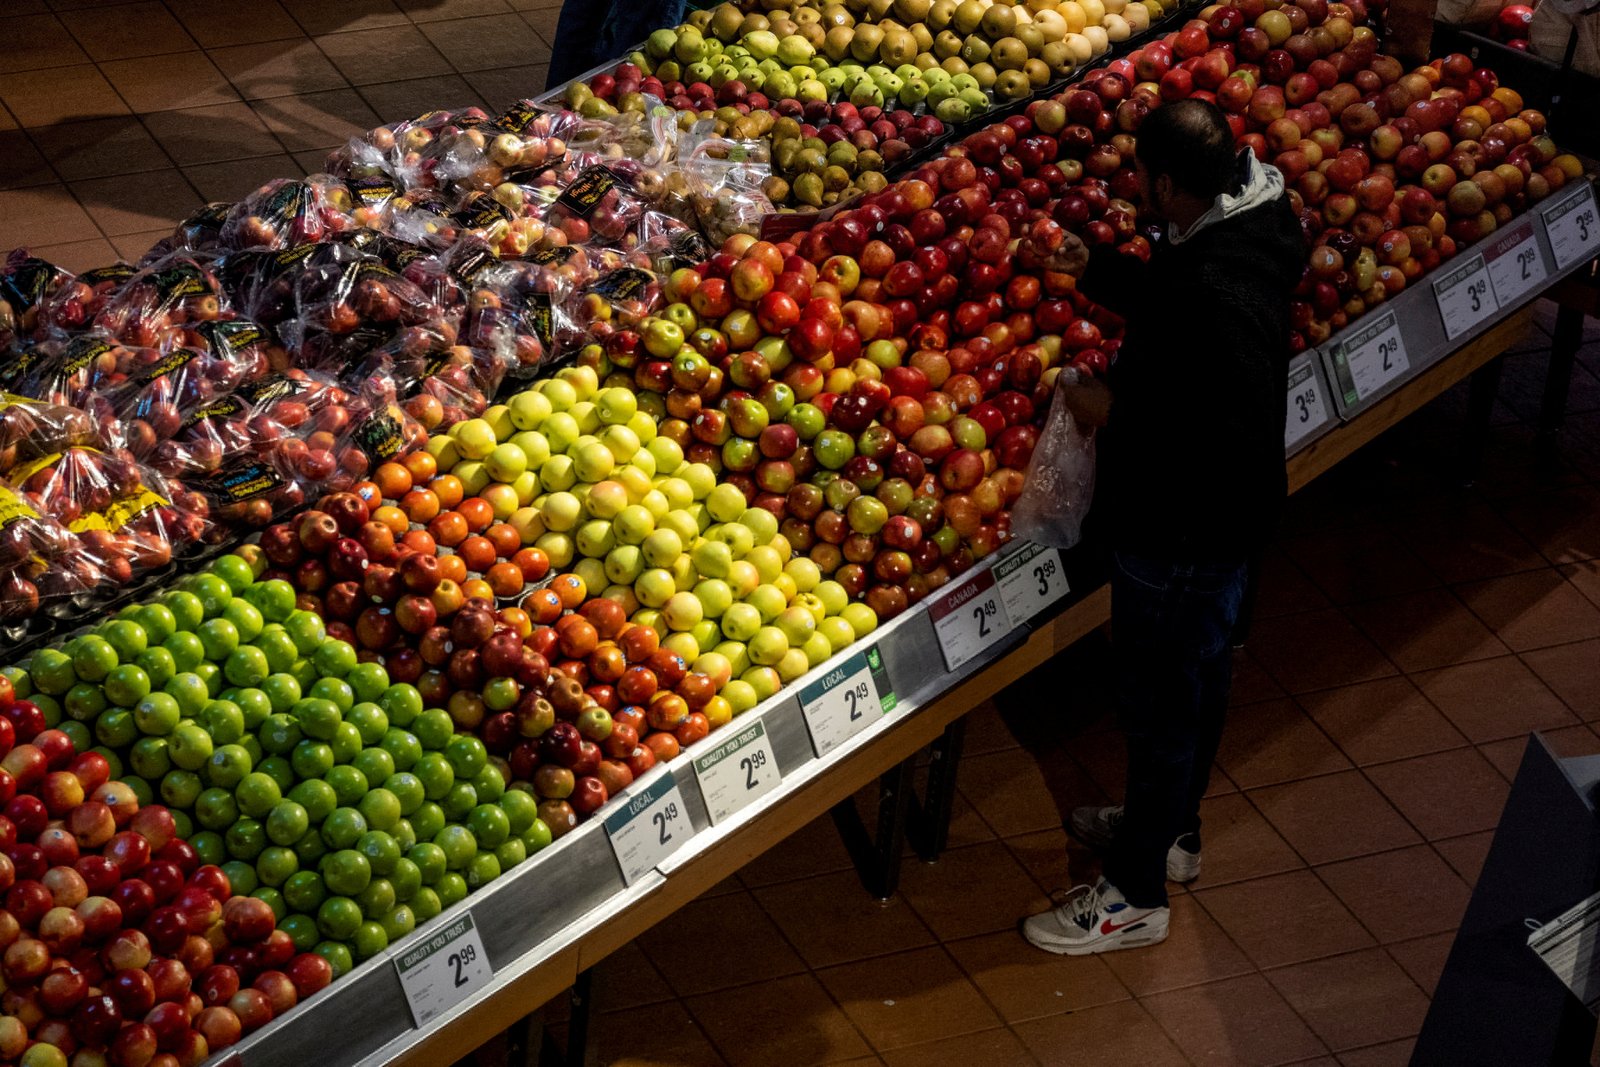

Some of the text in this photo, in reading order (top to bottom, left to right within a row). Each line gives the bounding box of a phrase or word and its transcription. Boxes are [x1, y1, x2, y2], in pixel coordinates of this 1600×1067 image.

[1497, 232, 1520, 254] CANADA
[948, 583, 979, 608] CANADA
[821, 668, 847, 690] LOCAL
[701, 727, 757, 769] QUALITY YOU TRUST
[628, 791, 654, 815] LOCAL
[403, 922, 467, 968] QUALITY YOU TRUST
